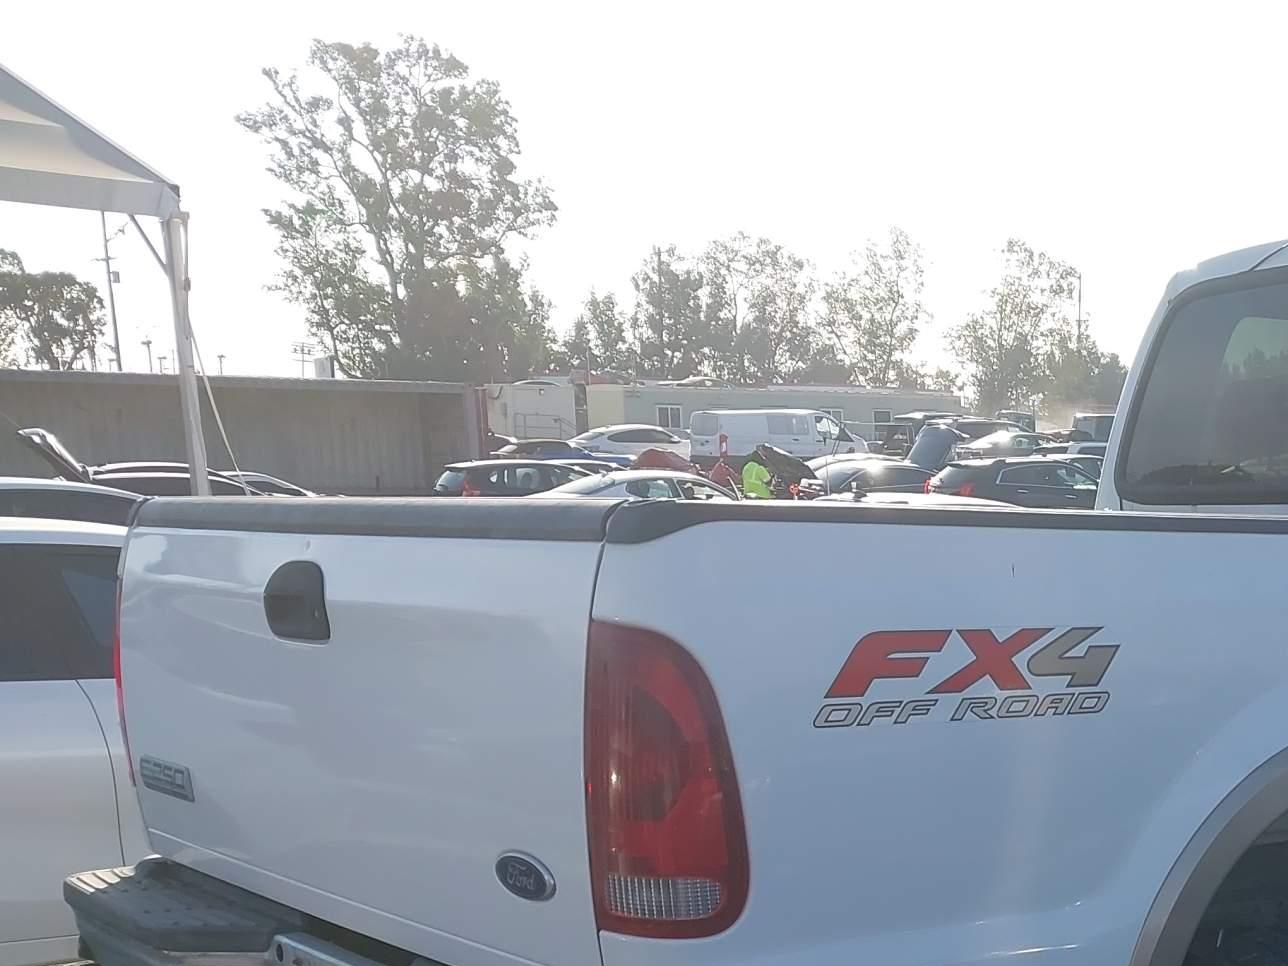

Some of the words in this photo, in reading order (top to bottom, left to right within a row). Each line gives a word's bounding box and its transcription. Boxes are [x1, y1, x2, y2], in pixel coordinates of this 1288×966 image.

[824, 626, 1121, 699] FX4
[813, 699, 939, 728] OFF
[950, 691, 1111, 722] ROAD
[506, 861, 537, 891] Ford
